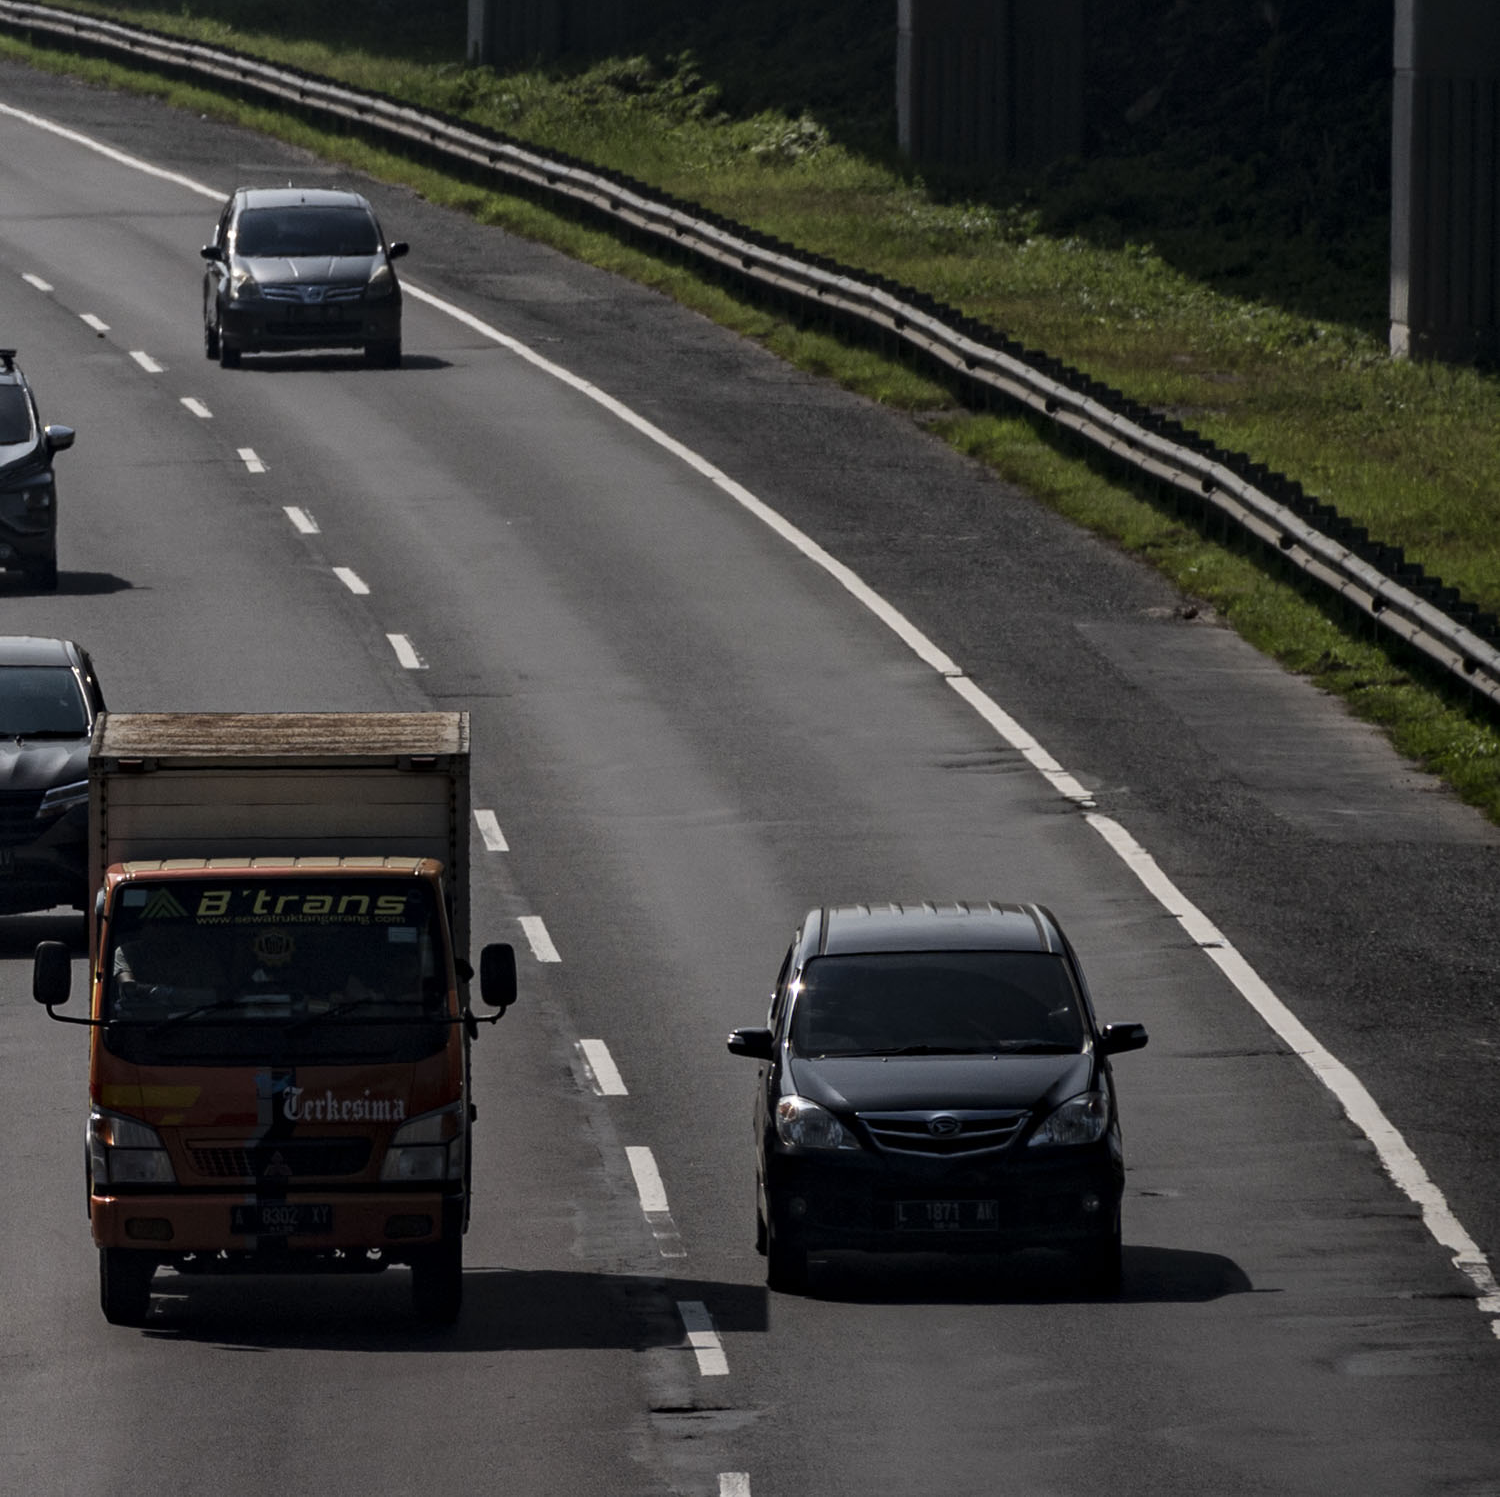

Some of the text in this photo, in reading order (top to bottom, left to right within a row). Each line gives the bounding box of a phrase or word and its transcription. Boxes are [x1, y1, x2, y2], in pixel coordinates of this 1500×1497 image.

[195, 914, 407, 926] www.sewatruktangerang.com
[282, 1085, 407, 1121] Terkesima
[235, 1205, 329, 1225] A 8302 XY
[898, 1202, 909, 1222] L
[925, 1202, 960, 1222] 1871
